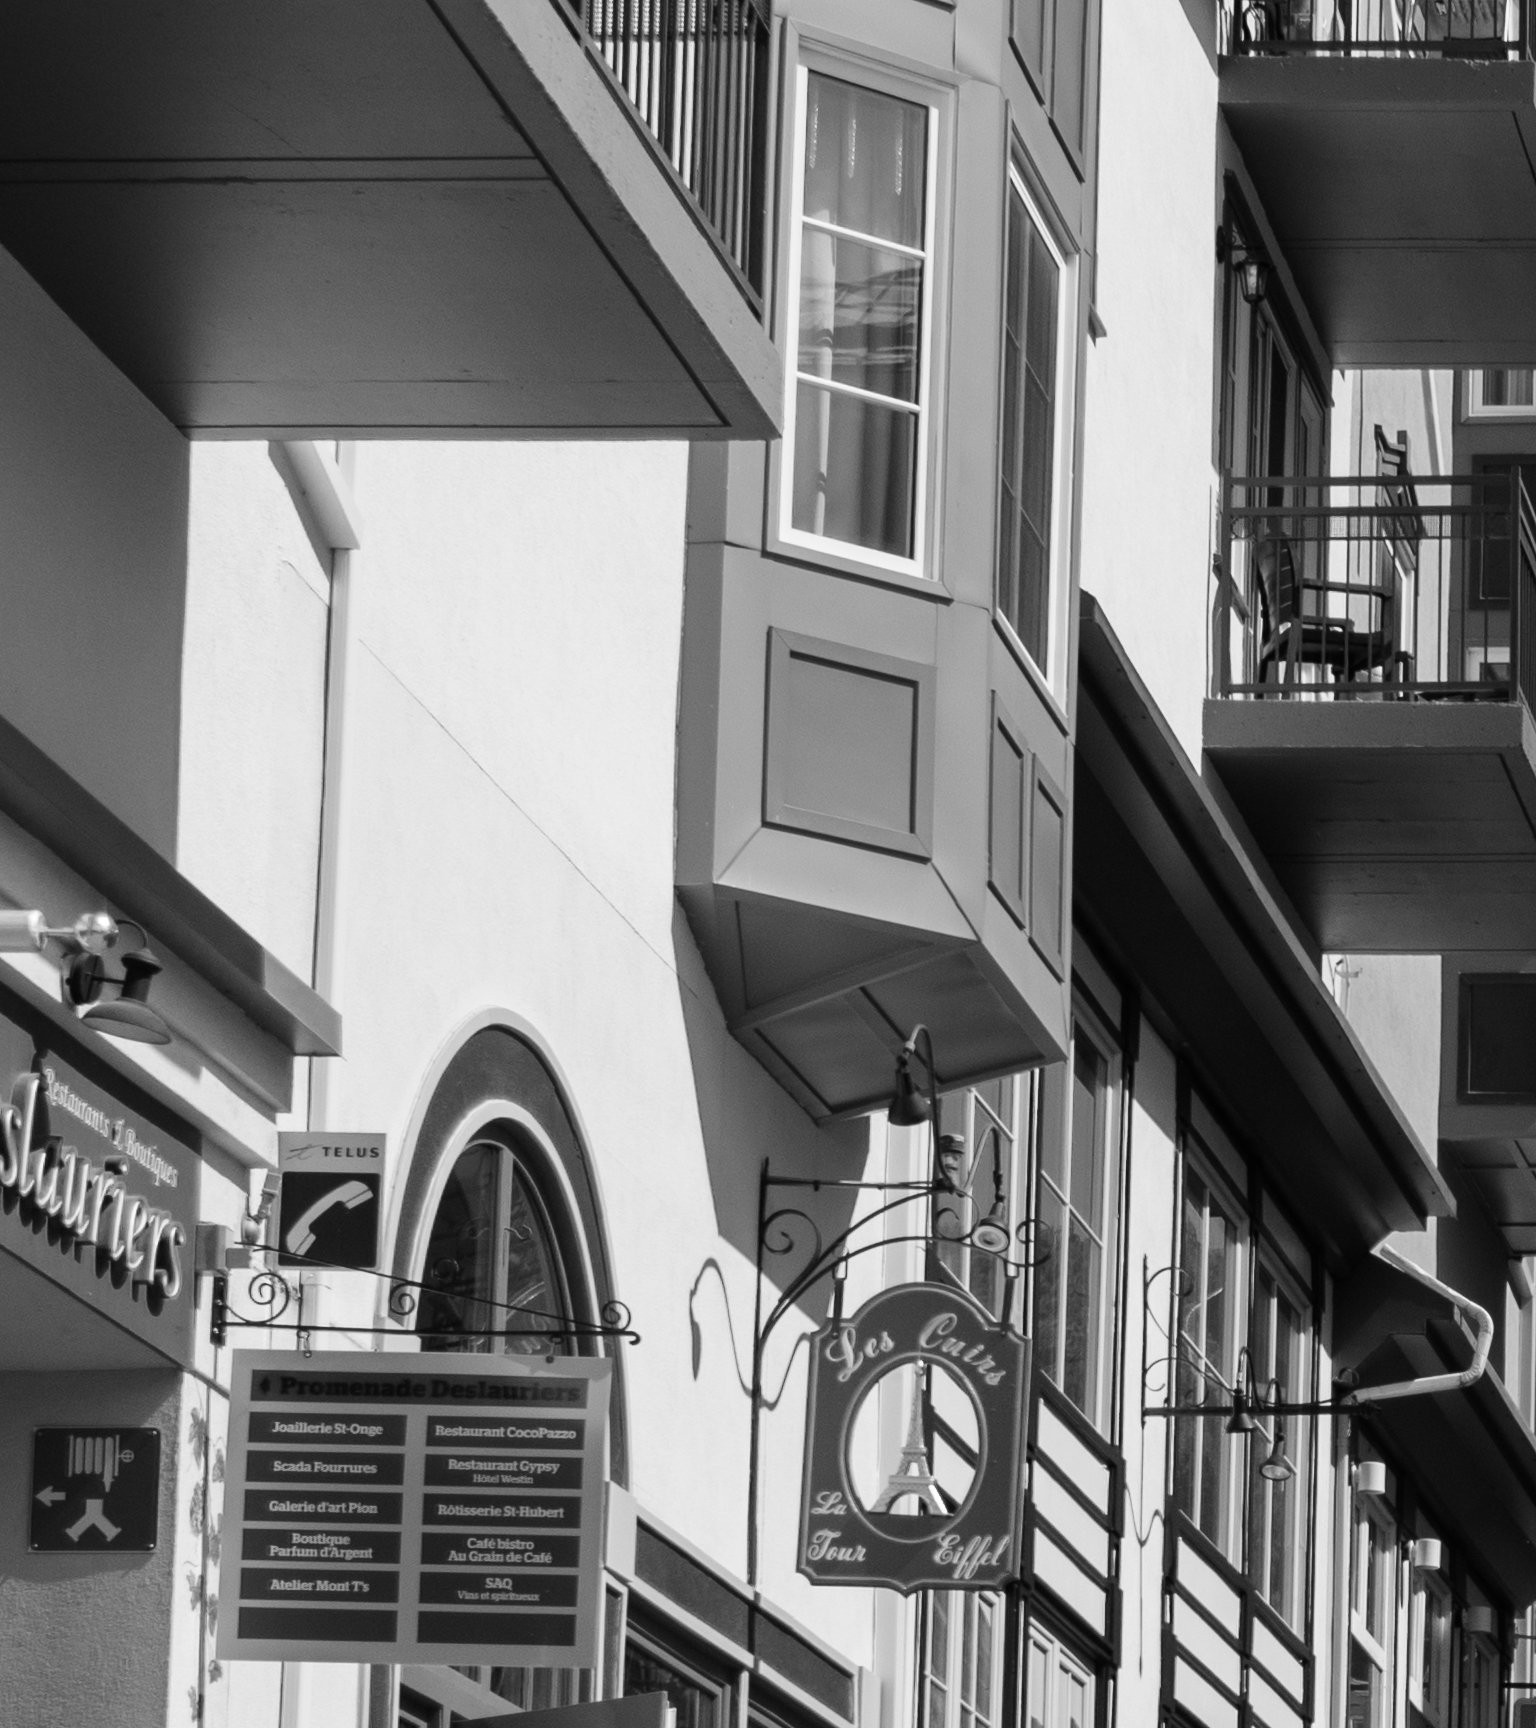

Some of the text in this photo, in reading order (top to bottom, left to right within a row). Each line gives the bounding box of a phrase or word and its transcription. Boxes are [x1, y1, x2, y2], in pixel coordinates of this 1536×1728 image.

[44, 1068, 111, 1138] Restaurants
[126, 1129, 178, 1188] Boutiques
[322, 1146, 380, 1158] TELUS
[0, 1074, 185, 1298] slauriers
[825, 1313, 1006, 1385] Les Cuirs
[280, 1376, 581, 1402] Promenade Deslauriers
[272, 1421, 384, 1437] Joaillerie St-Onge
[435, 1425, 577, 1440] Restaurant CocoPazzo
[273, 1460, 378, 1474] Scada Fourrures
[448, 1459, 561, 1475] Restaurant Gypsy
[473, 1474, 534, 1485] Hôtel Westin
[269, 1500, 379, 1515] Galerie d'art Pion
[438, 1503, 565, 1519] Rôtisserie St-Hubert
[811, 1492, 848, 1515] La
[292, 1532, 351, 1546] Boutique
[467, 1537, 535, 1551] Café bistro
[270, 1545, 373, 1560] Parfum d'Argent
[448, 1551, 552, 1564] Au Grain de Café
[807, 1528, 1010, 1579] Tour Eiffel
[270, 1579, 314, 1592] Atelier
[316, 1580, 350, 1592] Mont
[485, 1577, 513, 1591] SAQ
[457, 1590, 541, 1603] Vins et spiritueux
